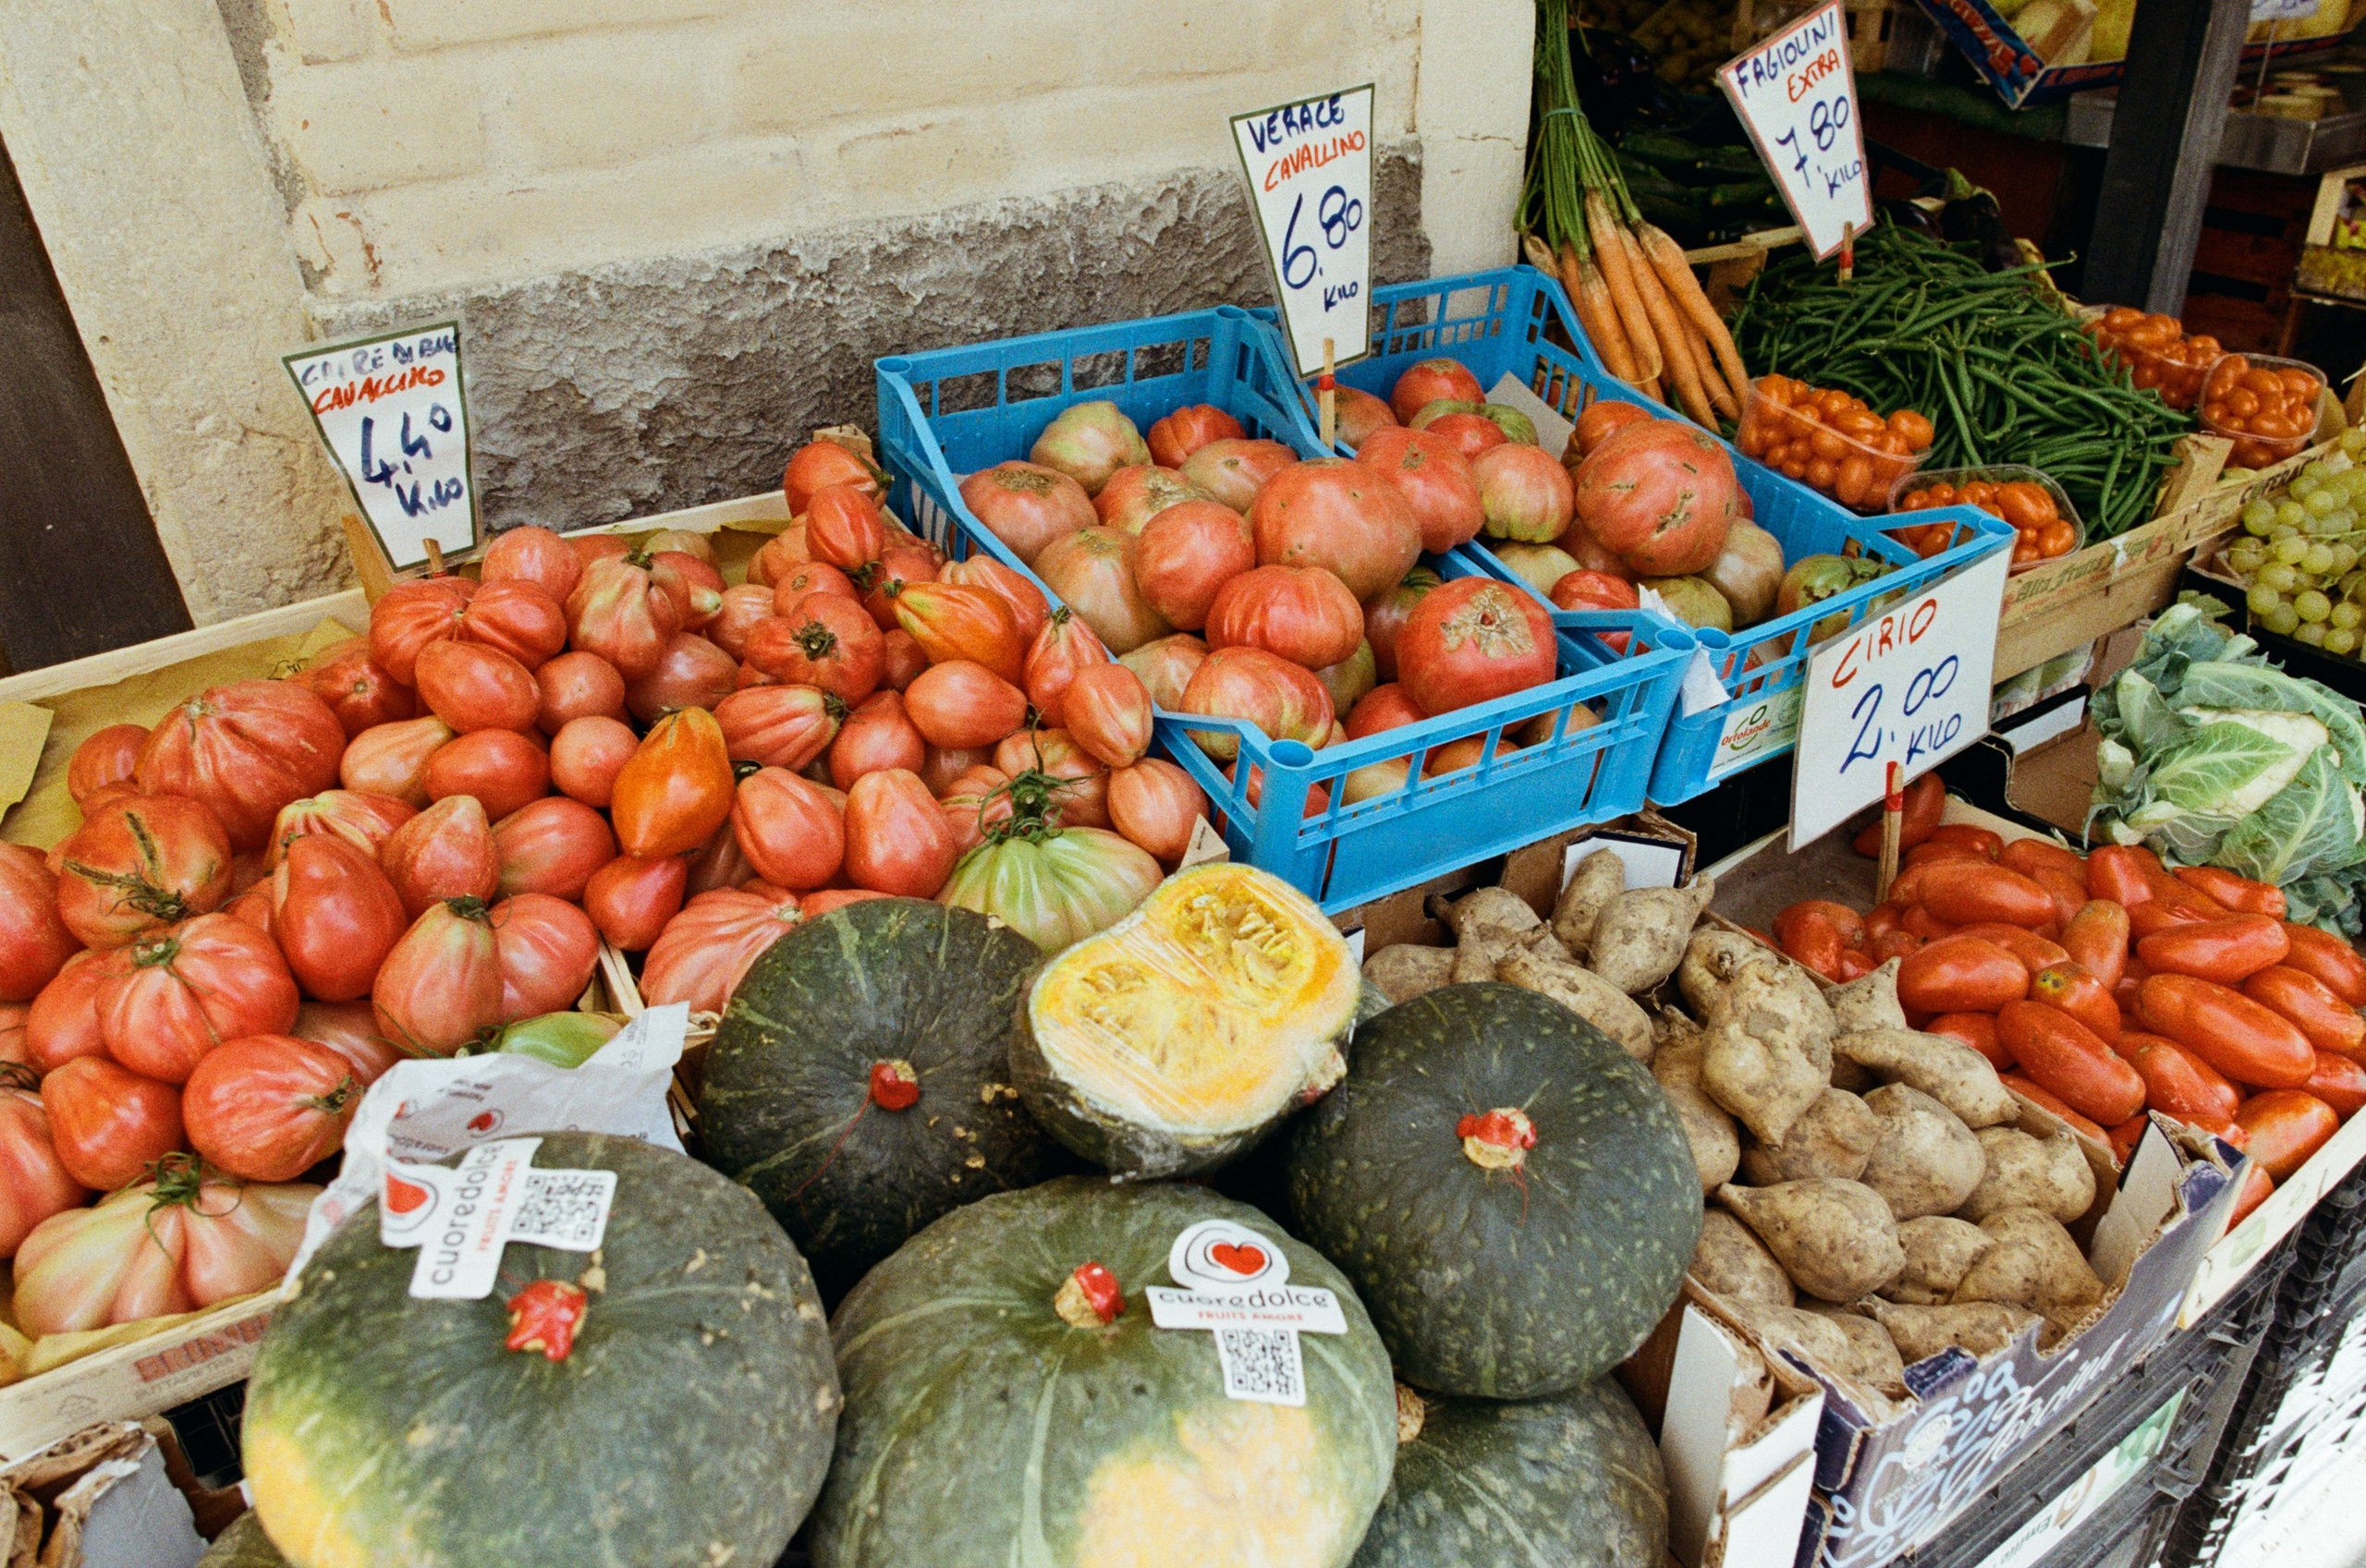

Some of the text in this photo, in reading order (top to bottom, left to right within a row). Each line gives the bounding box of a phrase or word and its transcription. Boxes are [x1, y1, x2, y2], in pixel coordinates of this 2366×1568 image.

[1735, 11, 1835, 98] FAGIOLINI
[1787, 48, 1840, 103] EXTRA
[1248, 92, 1345, 153] VERACE
[1264, 130, 1365, 192] CAVALLINO
[1824, 159, 1862, 199] KILO
[1323, 281, 1359, 313] KILO
[1831, 598, 1937, 689] CIRIO
[1905, 712, 1961, 766] KILO
[1159, 1289, 1329, 1308] cuoredolce
